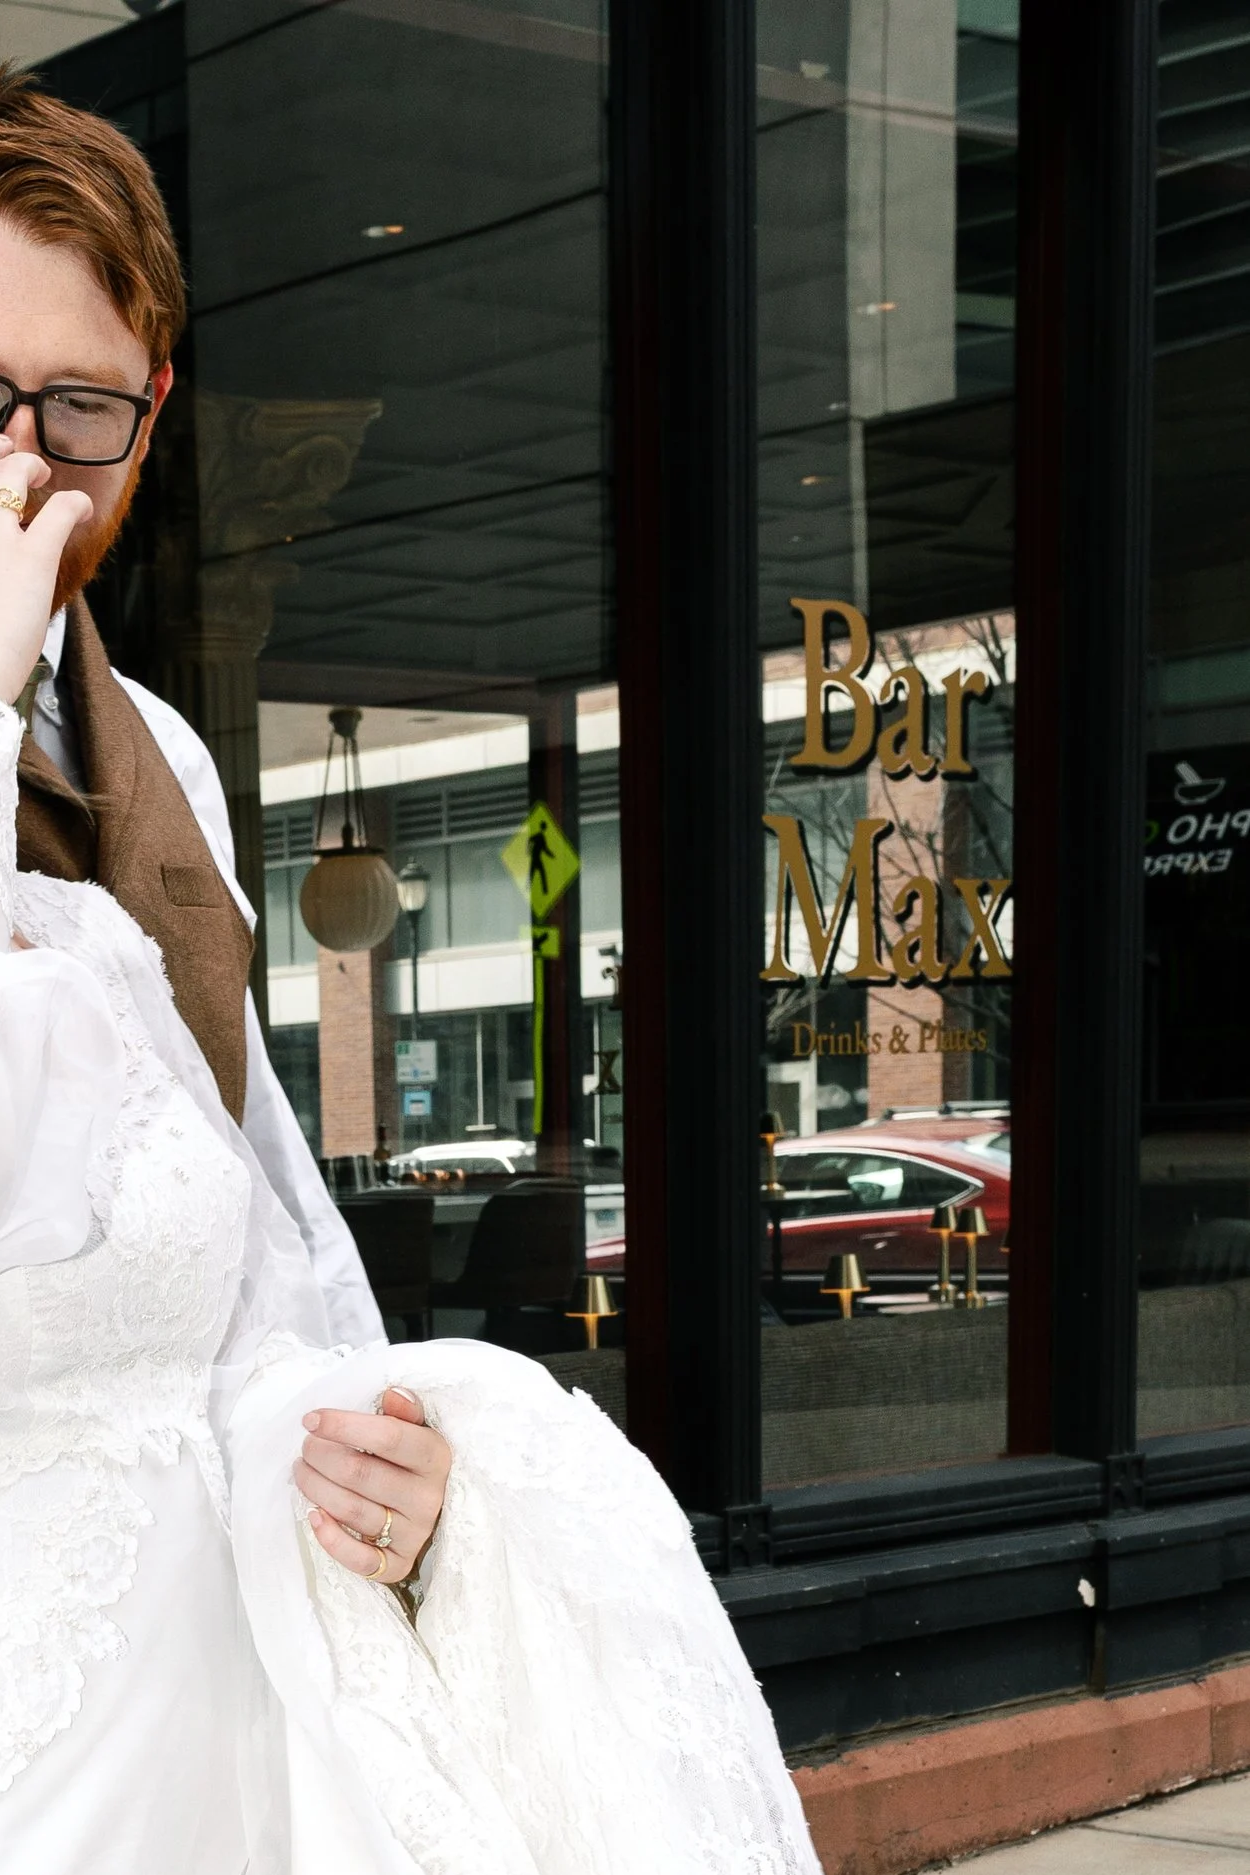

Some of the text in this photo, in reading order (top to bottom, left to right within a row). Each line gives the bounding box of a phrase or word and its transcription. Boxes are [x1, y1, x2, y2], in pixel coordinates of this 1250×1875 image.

[789, 597, 990, 774] Bar
[759, 814, 1013, 982] Max
[792, 1019, 988, 1057] Drinks & Plates
